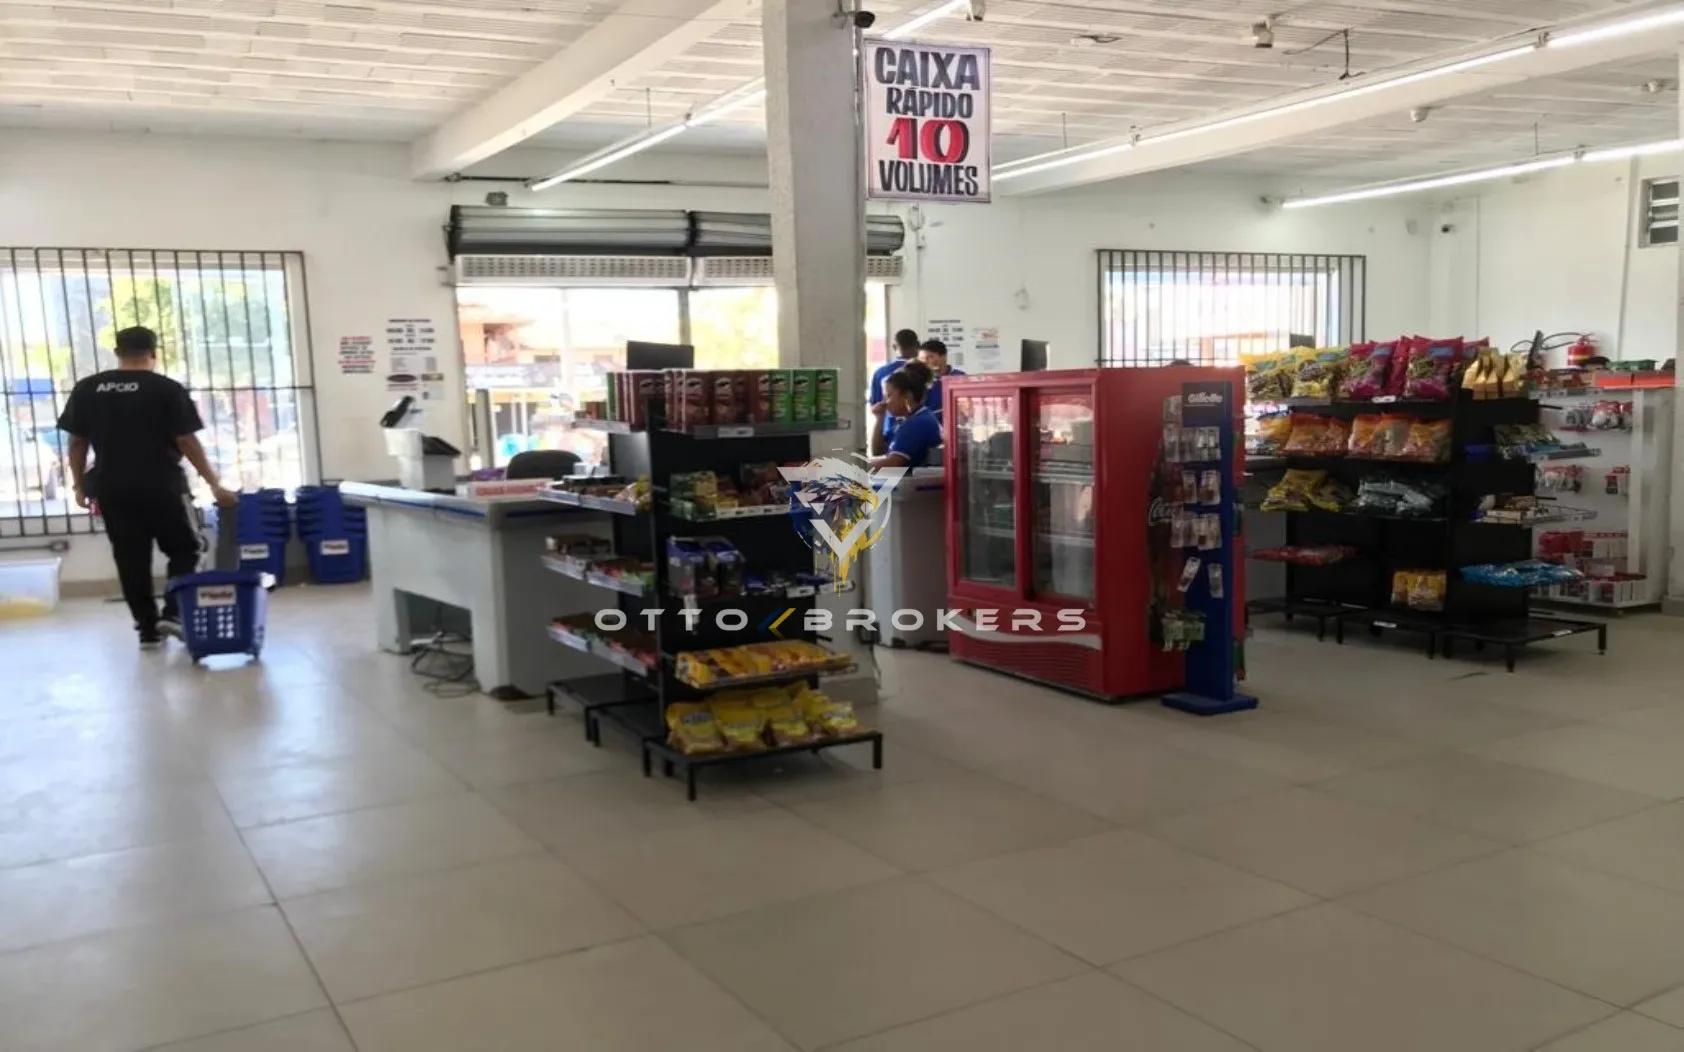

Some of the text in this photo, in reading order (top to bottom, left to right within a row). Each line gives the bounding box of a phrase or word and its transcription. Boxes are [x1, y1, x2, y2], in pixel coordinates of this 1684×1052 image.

[875, 47, 980, 91] CAIXA
[886, 117, 970, 163] 10
[878, 159, 979, 196] VOLUMES
[96, 382, 139, 393] APOIO
